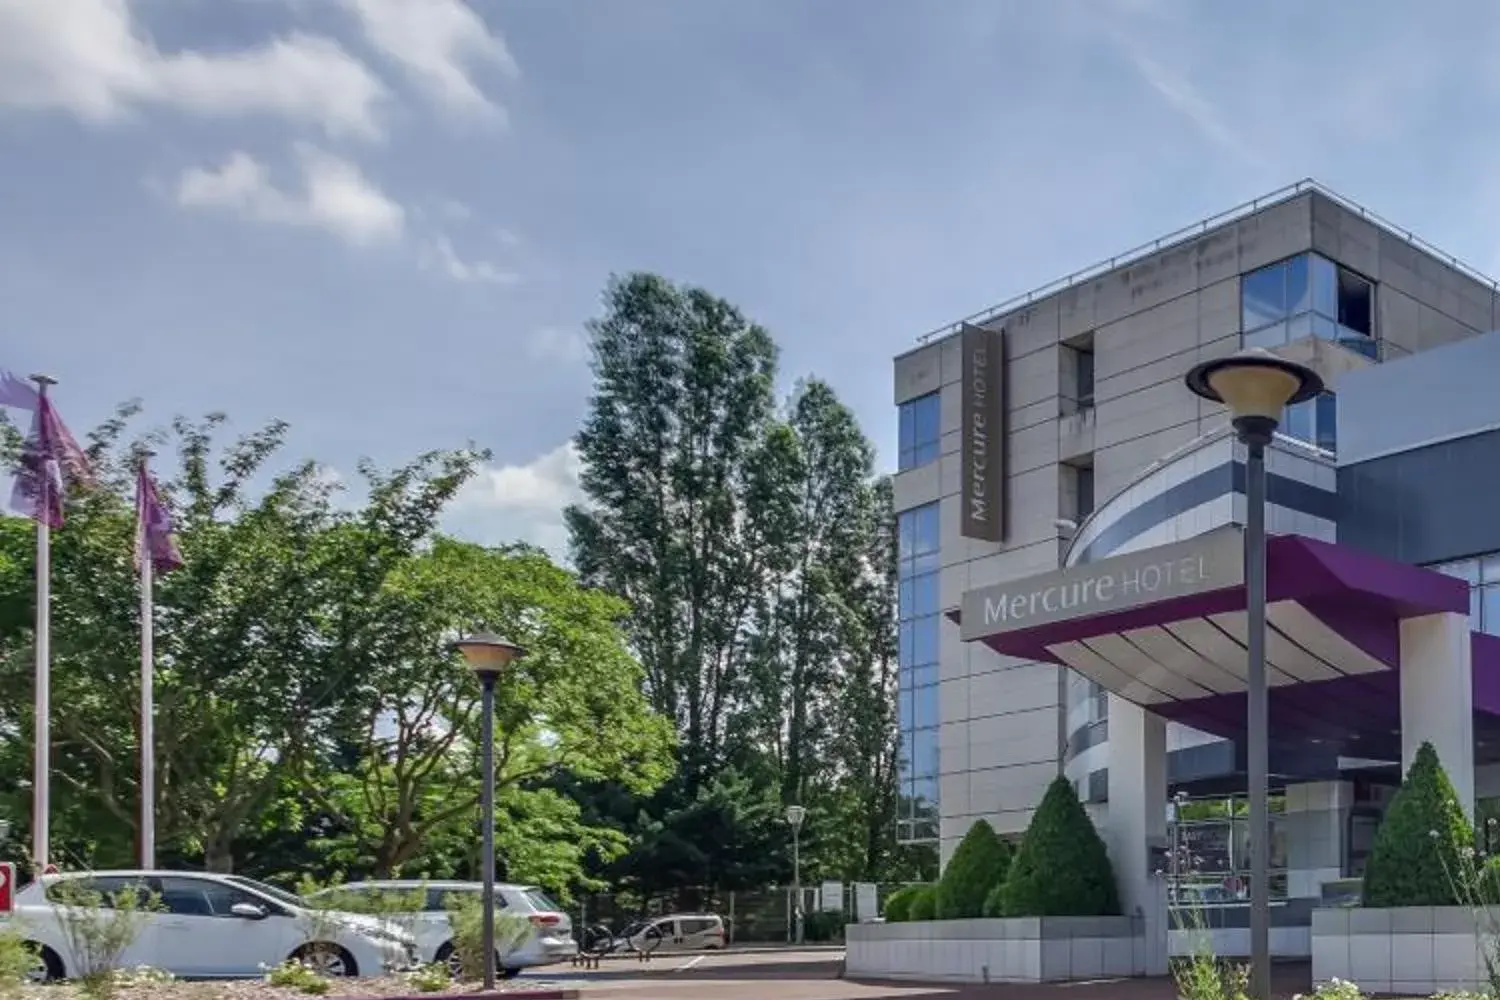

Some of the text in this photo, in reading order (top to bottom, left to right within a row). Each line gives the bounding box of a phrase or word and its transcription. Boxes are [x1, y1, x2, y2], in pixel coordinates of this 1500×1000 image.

[970, 412, 987, 521] Mercure
[984, 556, 1212, 625] Mercure HOTEL
